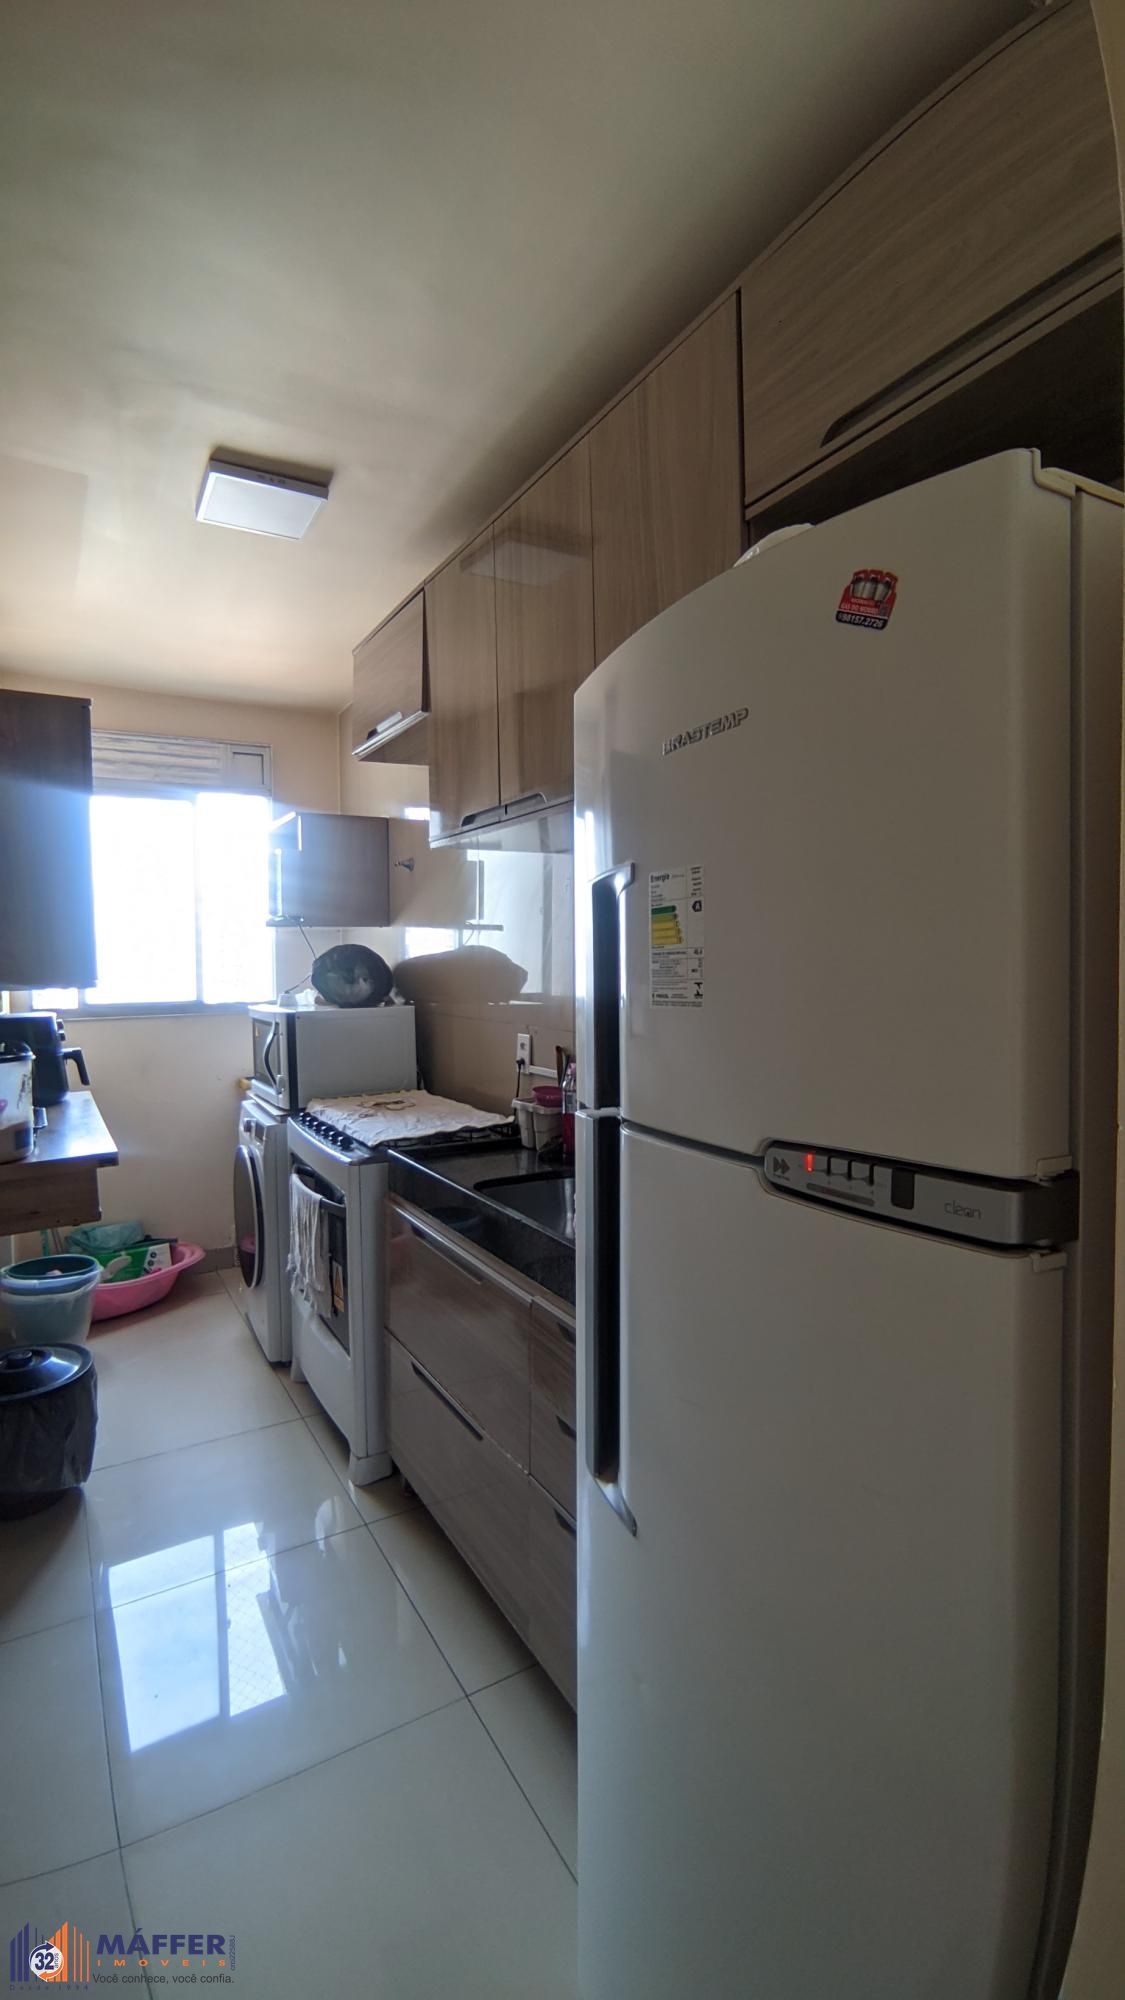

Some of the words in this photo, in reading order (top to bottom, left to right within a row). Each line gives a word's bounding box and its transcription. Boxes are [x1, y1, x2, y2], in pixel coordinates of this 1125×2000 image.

[662, 707, 749, 756] BRASTEMP
[650, 873, 670, 883] Energia
[944, 1200, 982, 1220] clean
